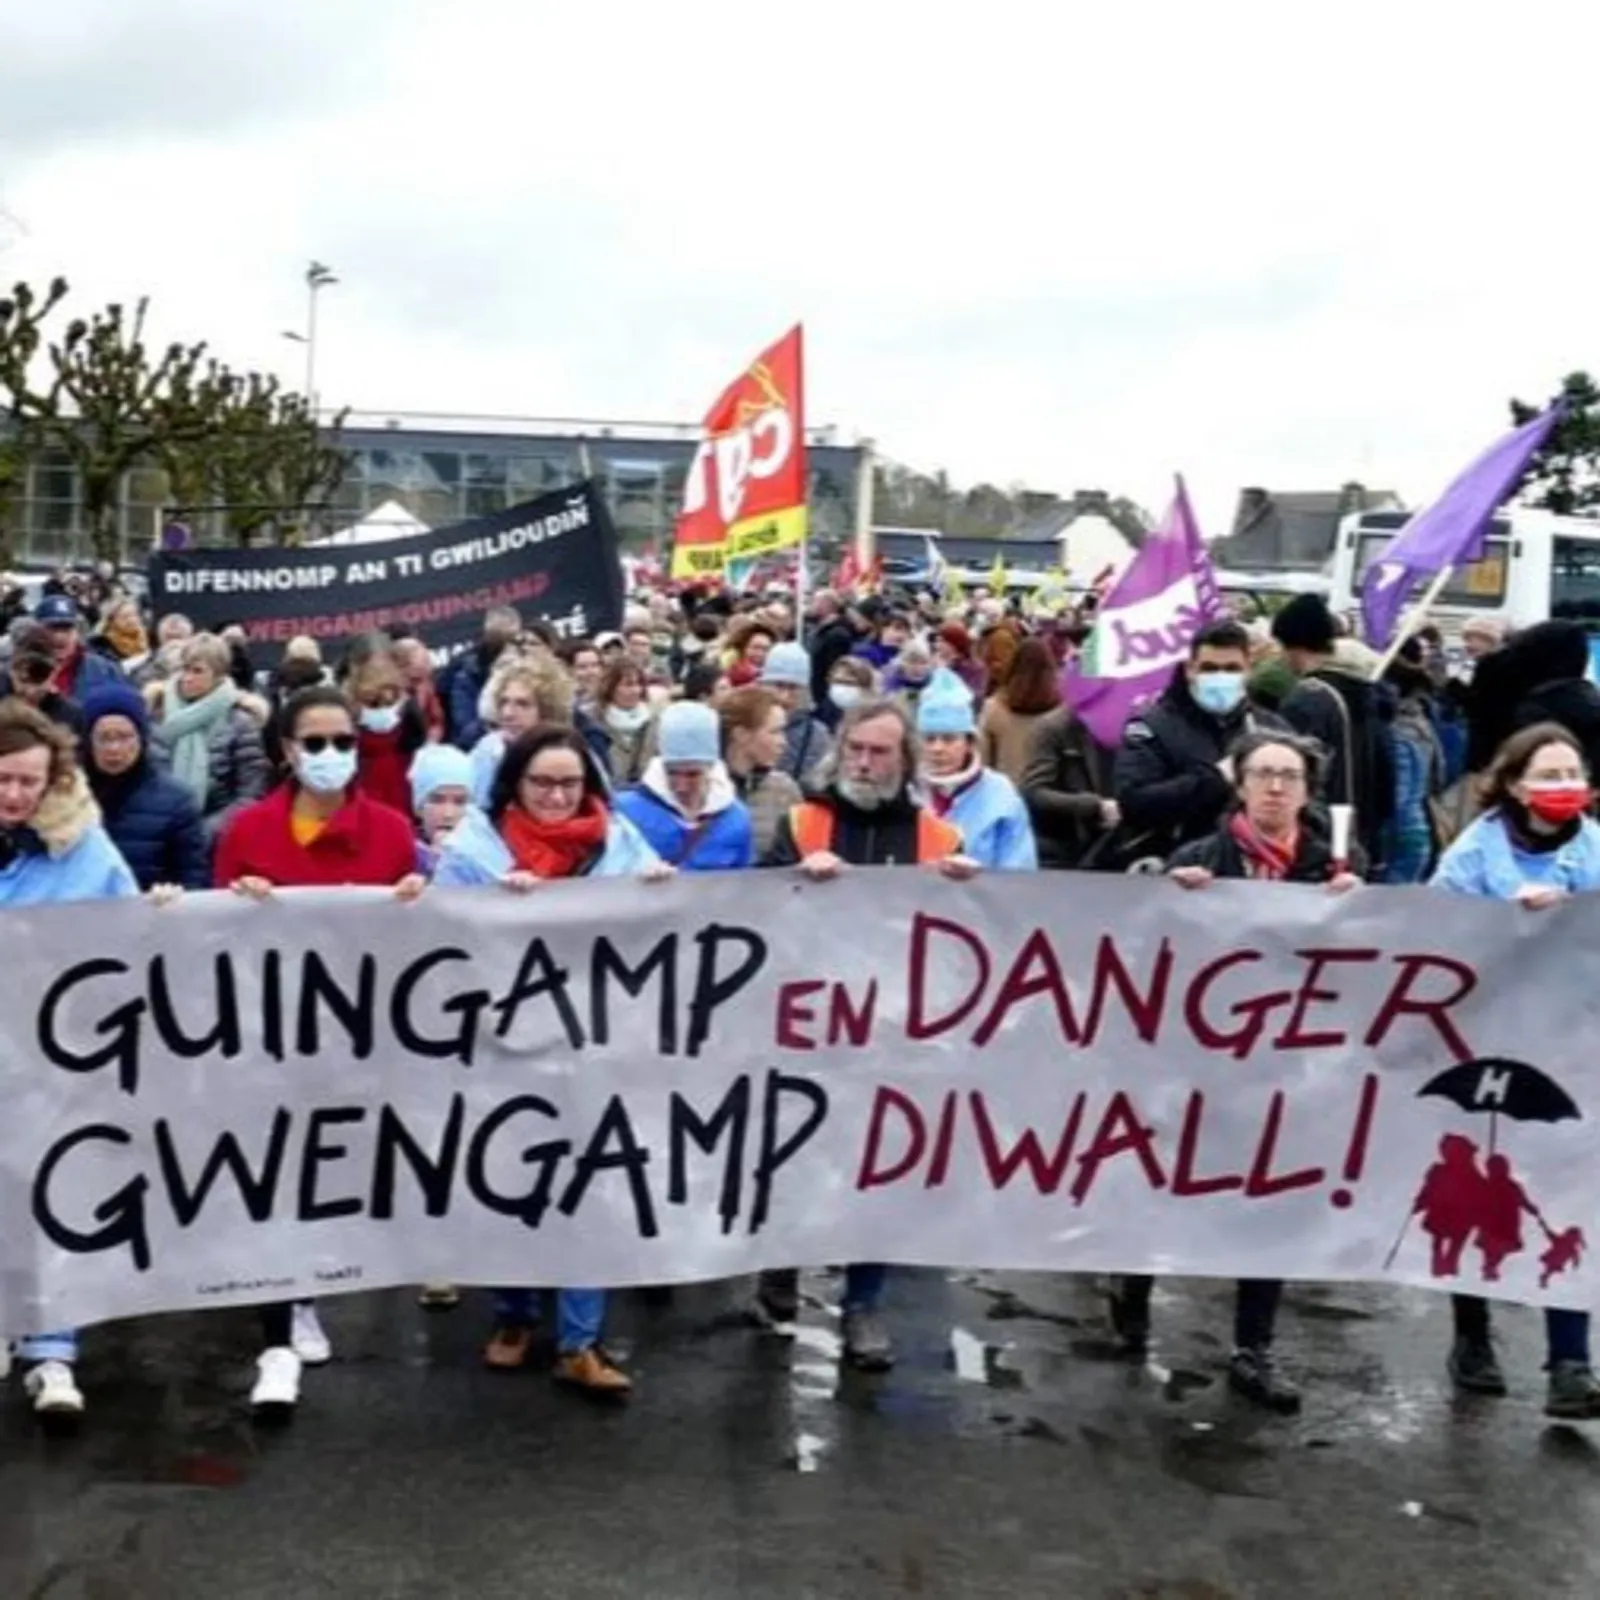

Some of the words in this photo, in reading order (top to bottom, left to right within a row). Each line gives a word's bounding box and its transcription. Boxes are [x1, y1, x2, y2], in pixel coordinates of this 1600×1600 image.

[165, 565, 337, 593] DIFENNOMP
[346, 560, 387, 585] AN
[395, 553, 424, 578] TI
[37, 923, 767, 1096] GUINGAMP
[776, 980, 877, 1050] EN
[906, 911, 1475, 1063] DANGER
[1473, 1065, 1513, 1105] H
[31, 1068, 829, 1272] GWENGAMP
[856, 1073, 1378, 1209] DIWALL!
